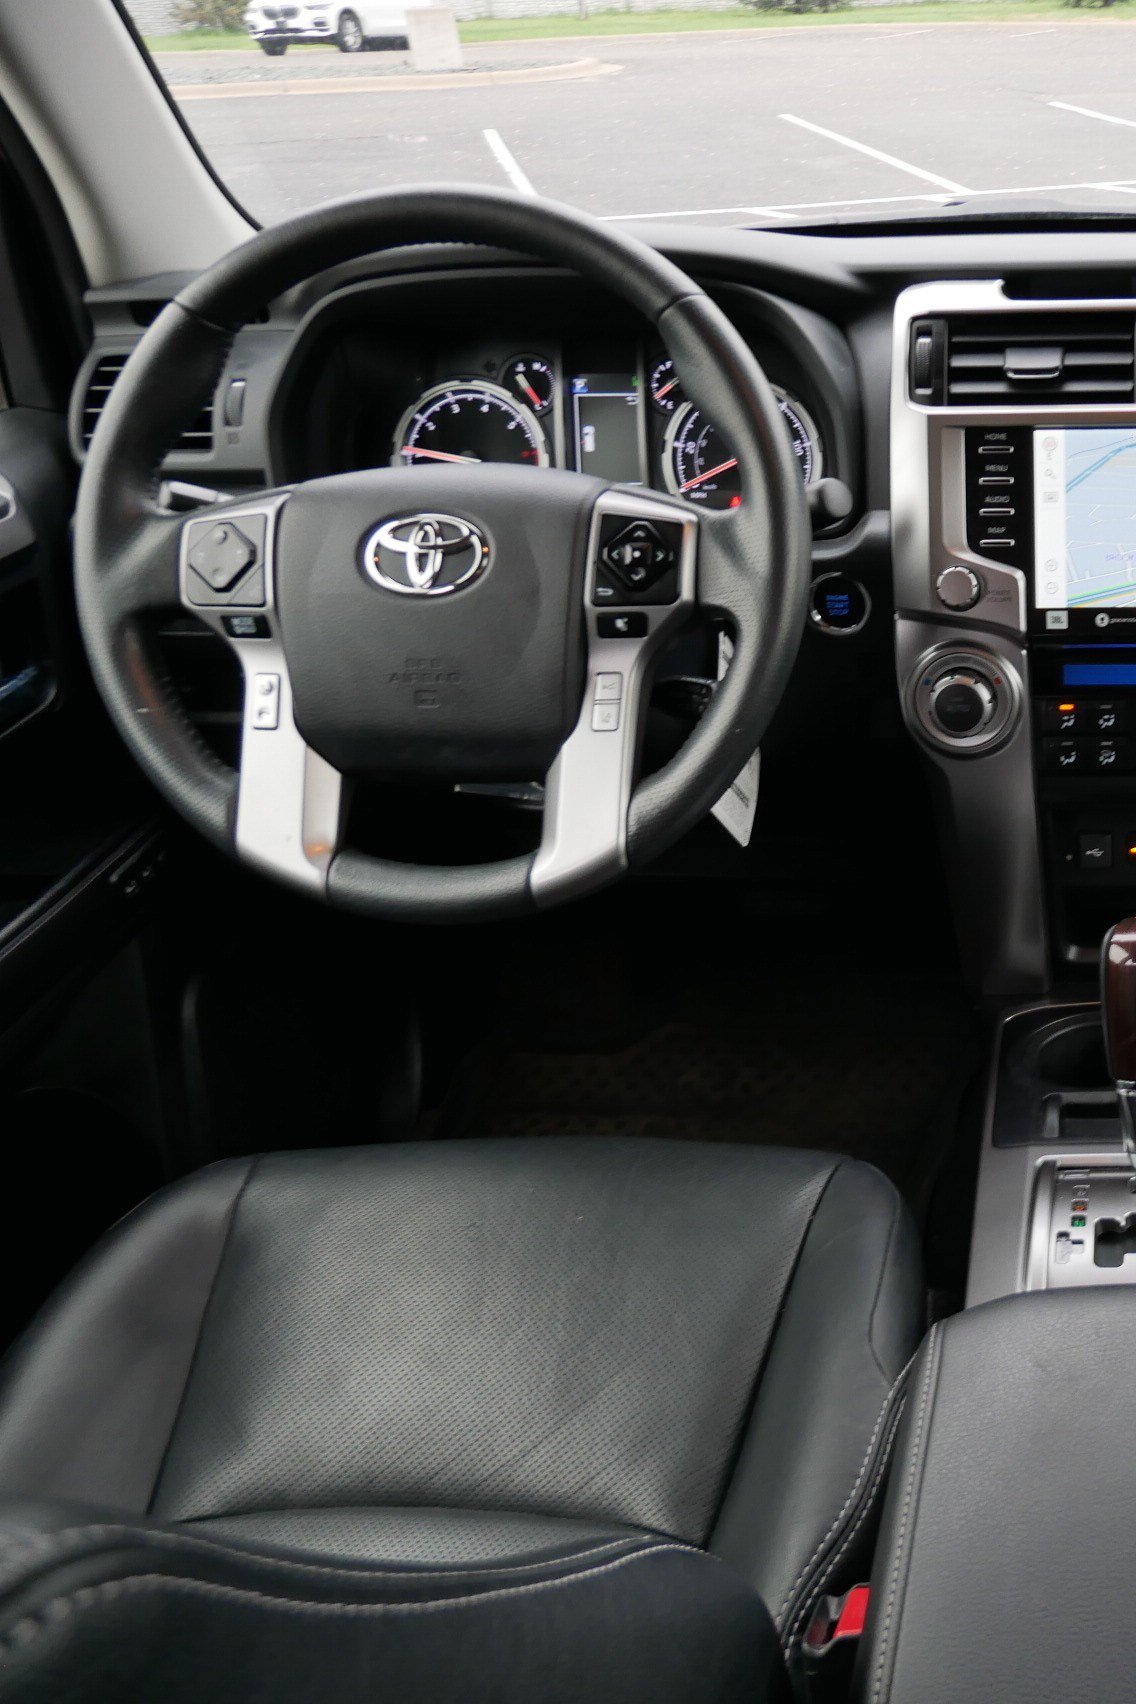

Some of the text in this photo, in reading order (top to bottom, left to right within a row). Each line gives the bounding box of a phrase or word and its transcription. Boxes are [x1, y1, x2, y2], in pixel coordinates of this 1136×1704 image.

[451, 403, 461, 414] 3
[480, 403, 490, 414] 4
[984, 433, 1008, 441] HOME
[685, 441, 697, 454] 20
[792, 439, 805, 457] 100
[984, 495, 1010, 503] AUDIO
[987, 526, 1007, 534] MAP
[828, 608, 850, 616] STOP
[385, 671, 461, 685] AIRBAG
